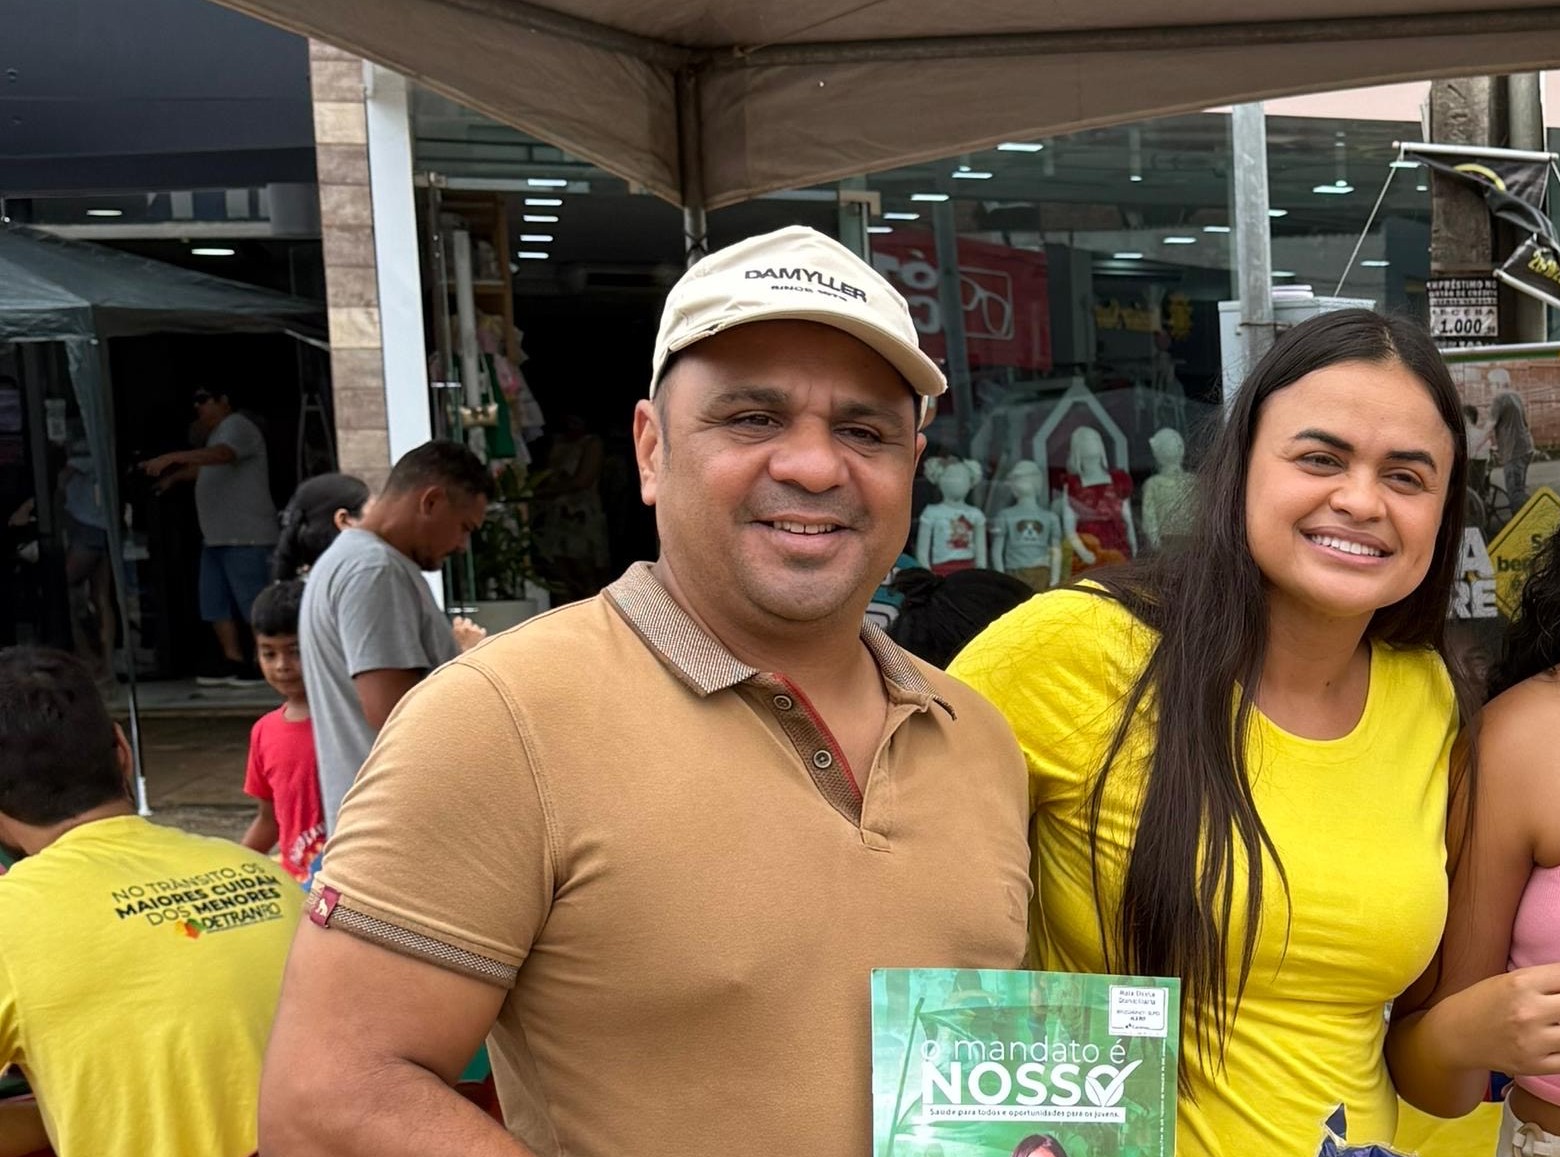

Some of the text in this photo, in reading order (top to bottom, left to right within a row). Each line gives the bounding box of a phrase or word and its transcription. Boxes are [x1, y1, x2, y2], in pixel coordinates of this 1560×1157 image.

[744, 267, 868, 302] DAMYLLER
[1440, 318, 1482, 334] 1.000
[111, 884, 146, 904] NO
[114, 887, 210, 920] MAIORES
[145, 887, 282, 927] DOS MENORES
[921, 1035, 1127, 1064] o mandato é
[921, 1060, 1130, 1107] NOSSO
